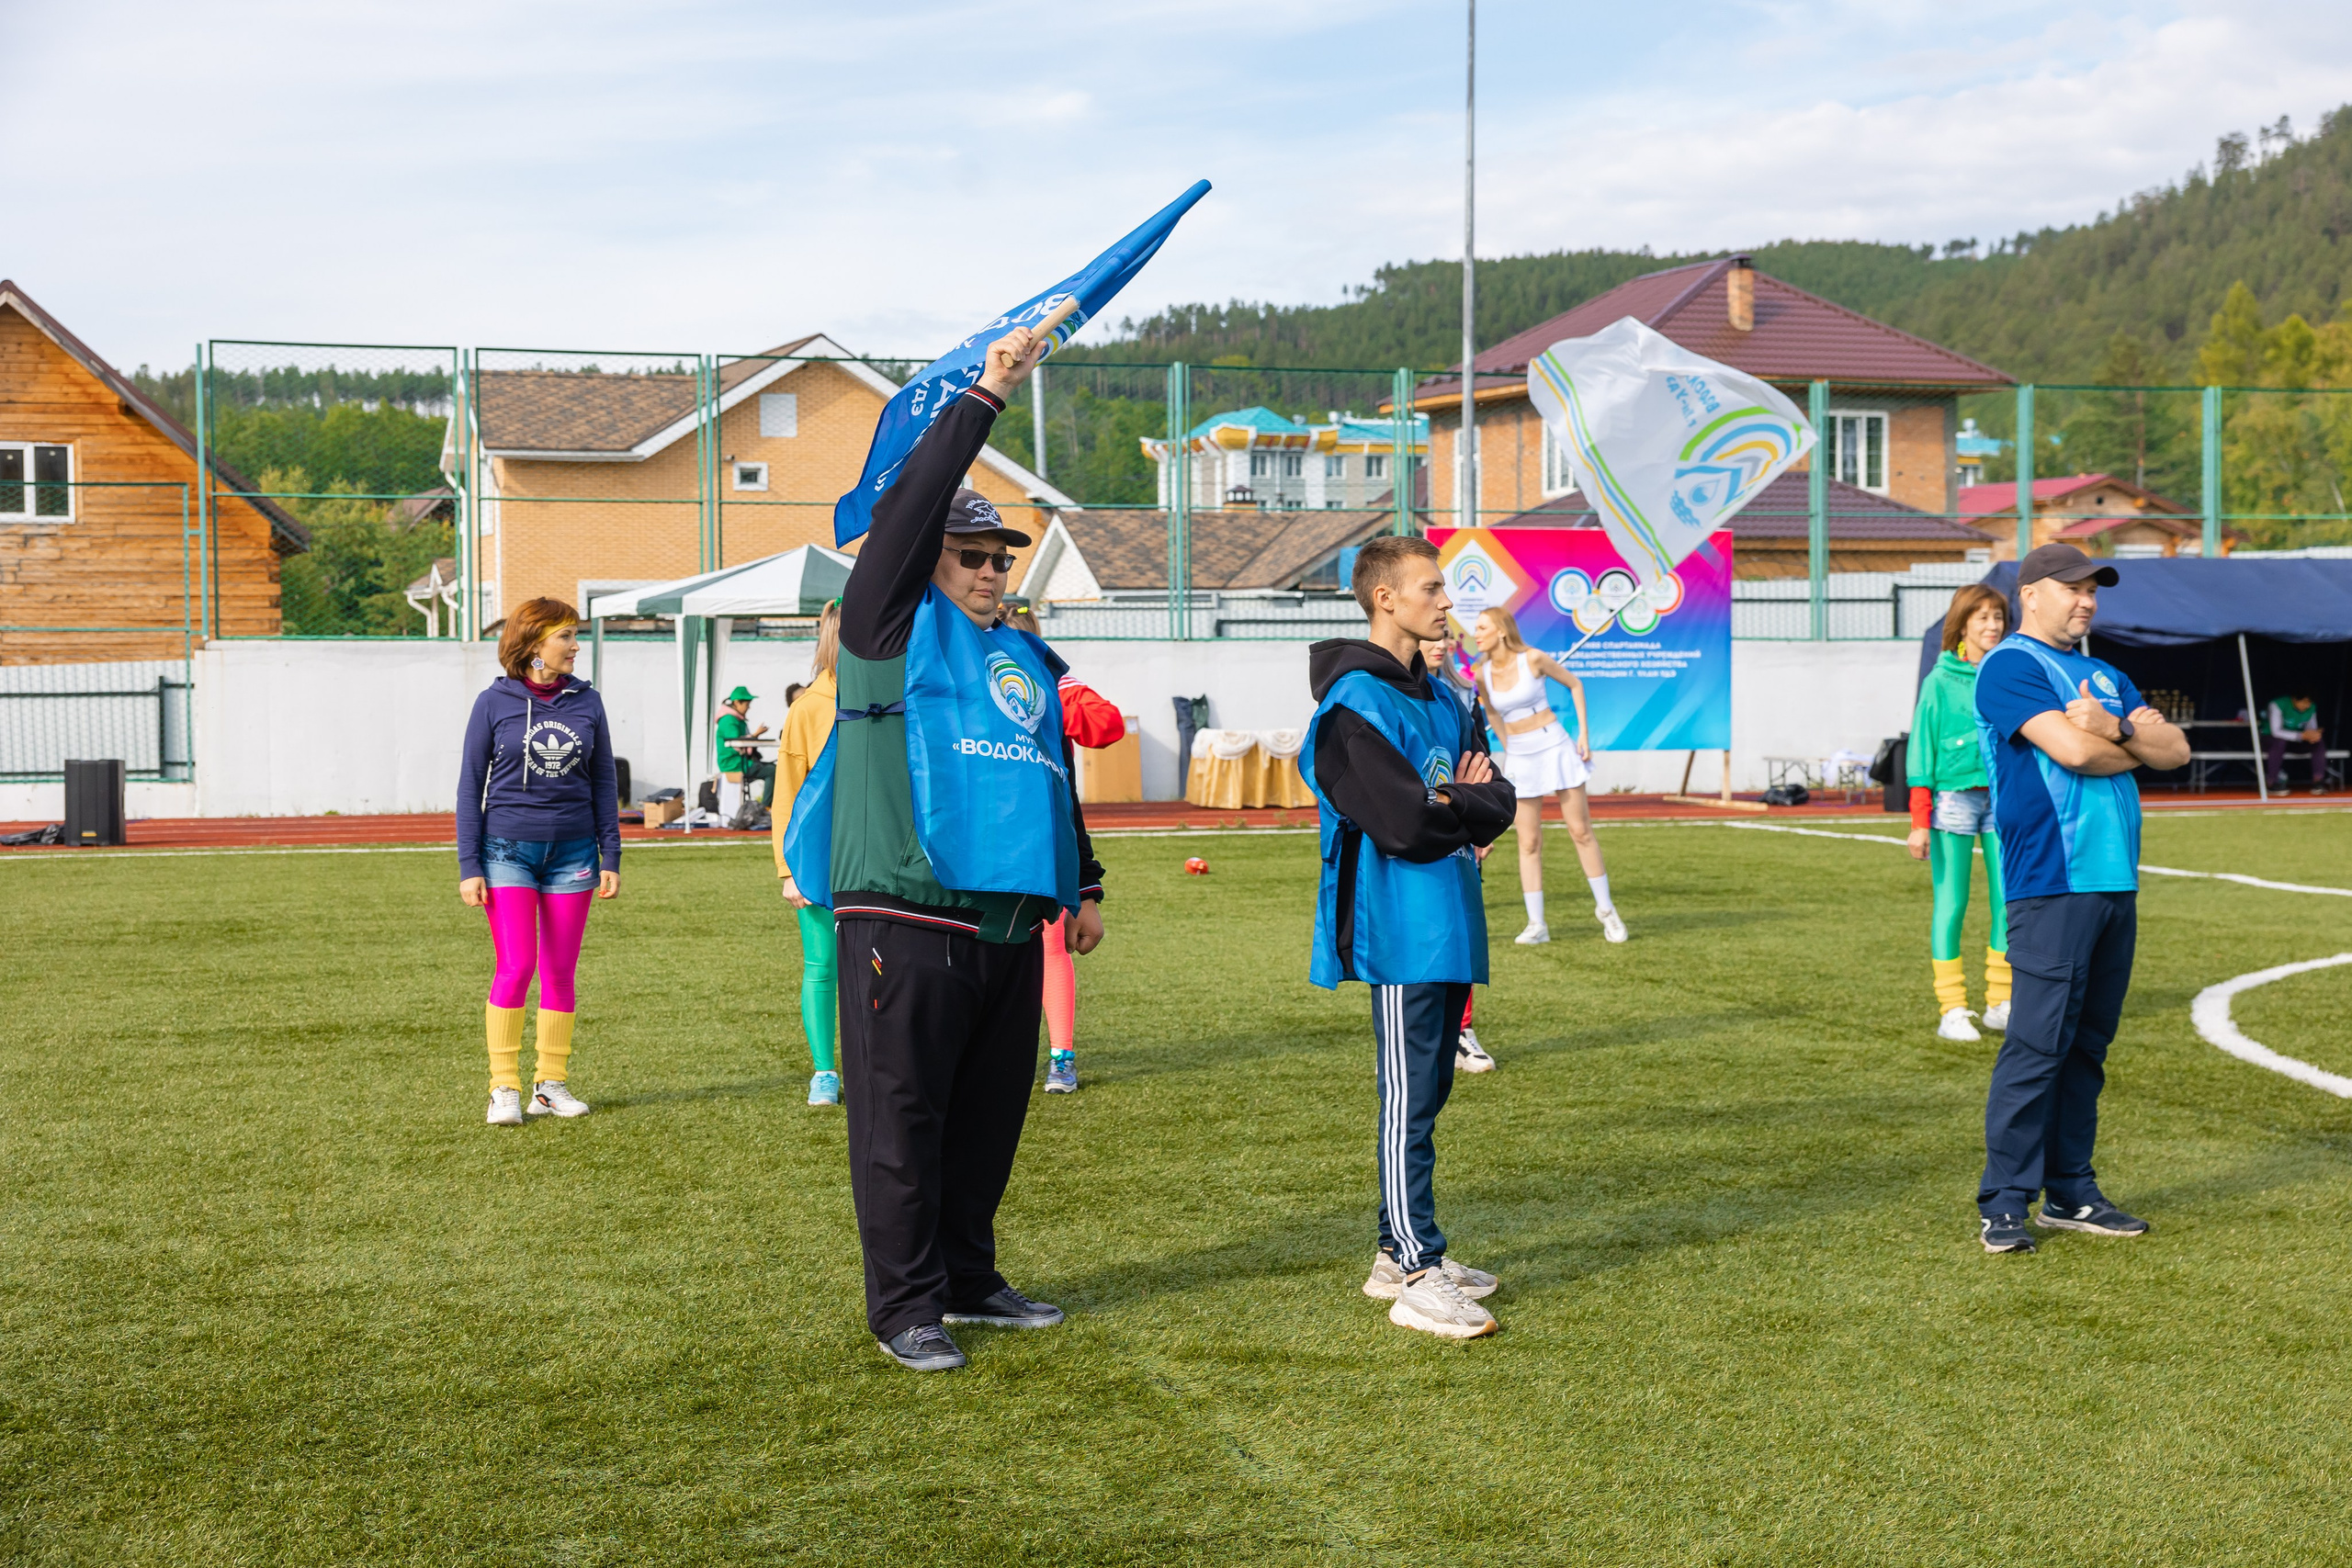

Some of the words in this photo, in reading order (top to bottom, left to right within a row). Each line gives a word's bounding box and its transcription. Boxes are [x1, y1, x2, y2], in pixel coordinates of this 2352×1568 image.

[543, 720, 582, 746] ORIGINALS
[1015, 733, 1037, 747] МУП
[535, 766, 546, 776] OF
[545, 770, 560, 778] THE
[545, 761, 560, 770] 1972
